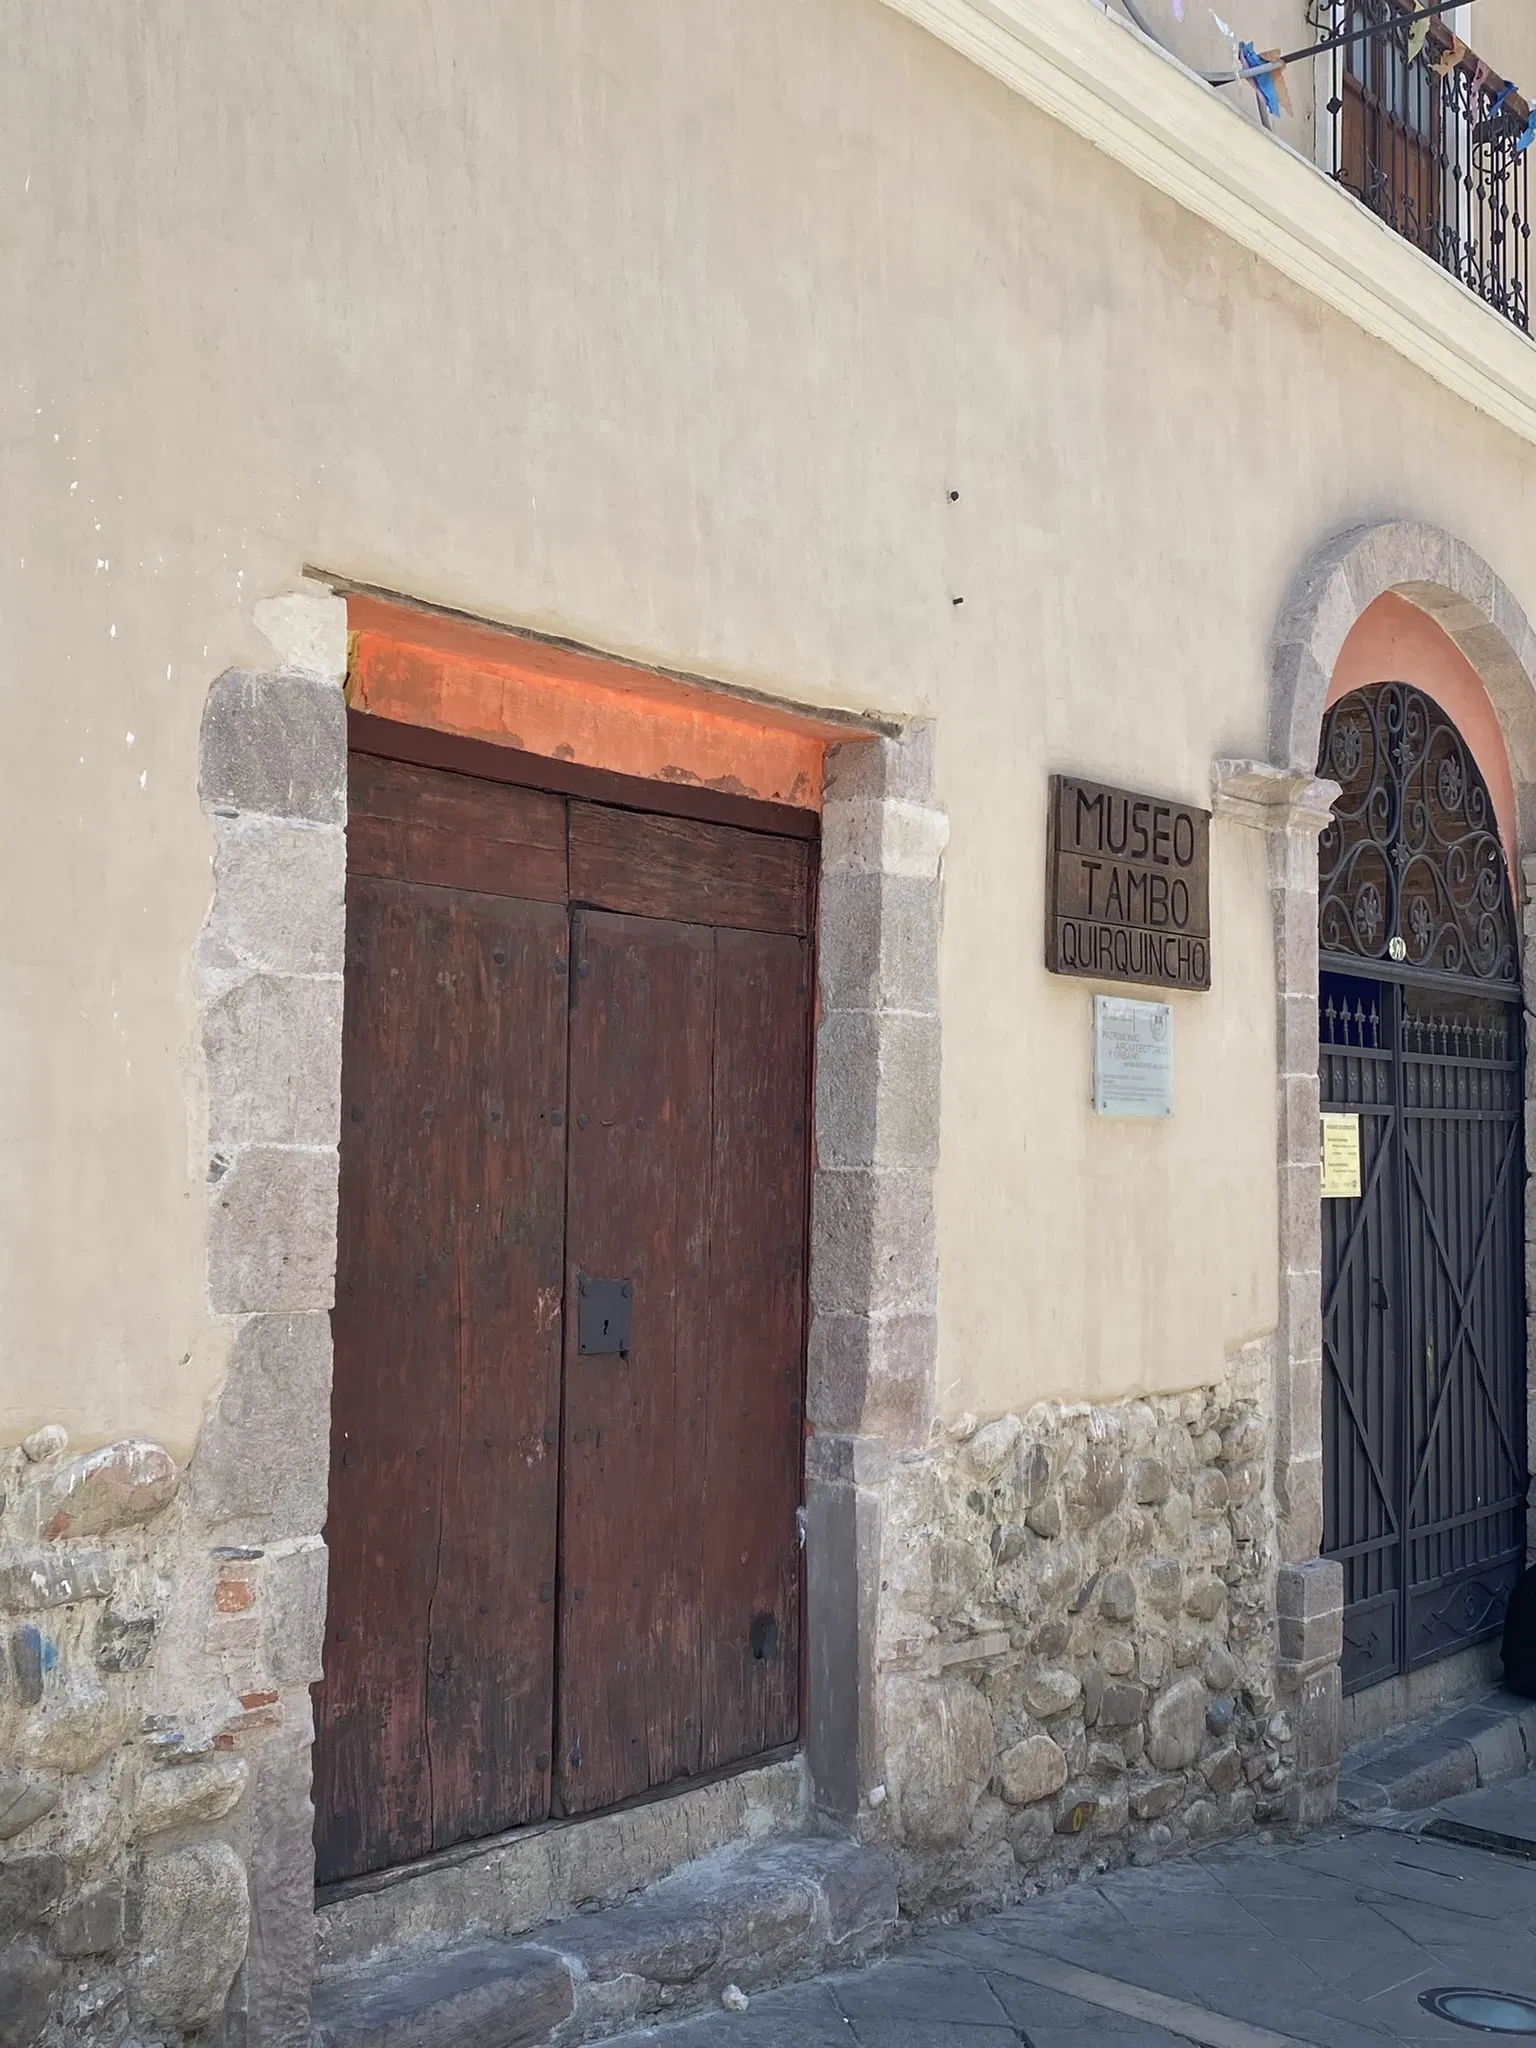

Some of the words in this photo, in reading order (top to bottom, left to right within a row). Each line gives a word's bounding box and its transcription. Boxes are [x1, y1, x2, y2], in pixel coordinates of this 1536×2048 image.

[1075, 787, 1195, 868] MUSEO
[1081, 860, 1190, 930] TAMBO
[1062, 921, 1207, 982] QUIRQUINCHO
